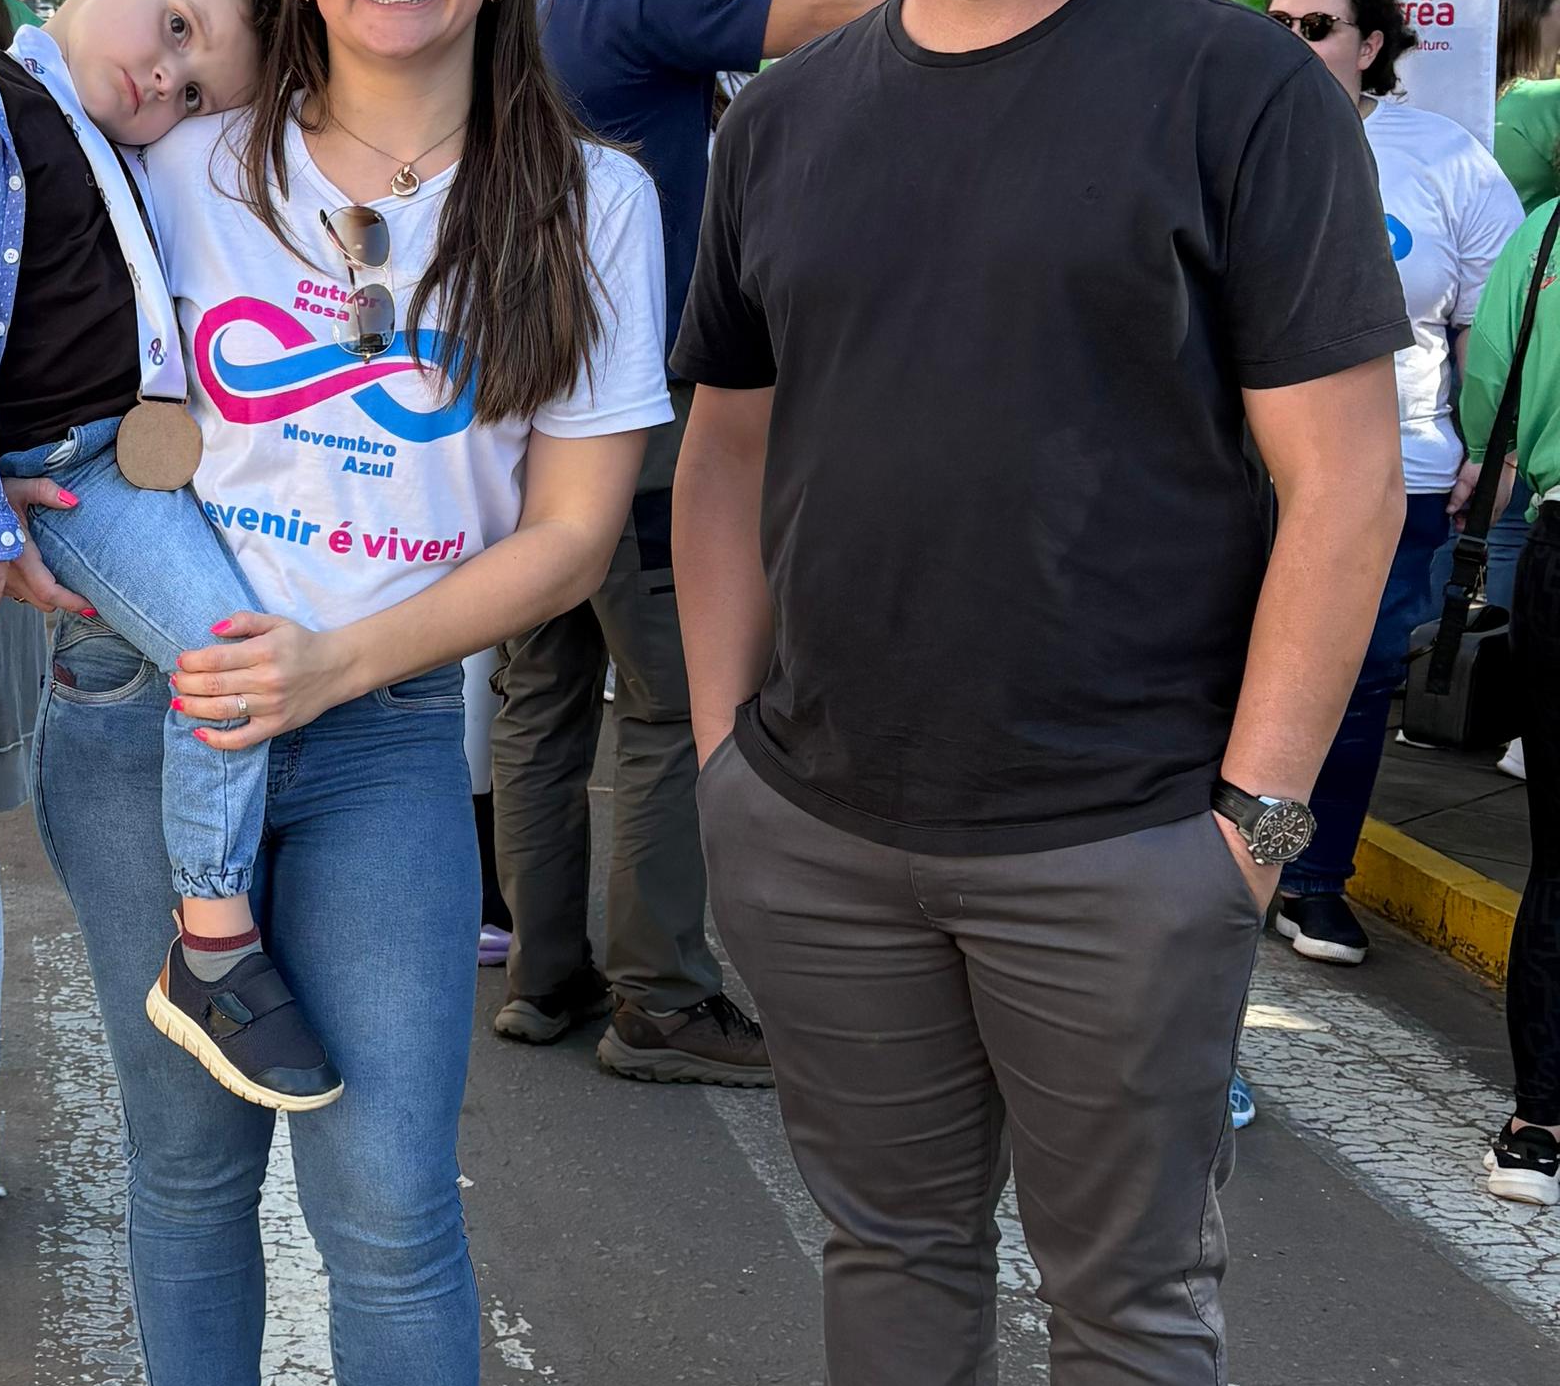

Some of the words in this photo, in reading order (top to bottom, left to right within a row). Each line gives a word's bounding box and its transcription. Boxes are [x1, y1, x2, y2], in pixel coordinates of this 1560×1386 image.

[293, 296, 350, 322] Rosa
[283, 423, 397, 457] Novembro
[341, 455, 394, 478] Azul
[204, 500, 321, 546] evenir
[328, 521, 353, 554] é
[362, 527, 466, 563] viver!
